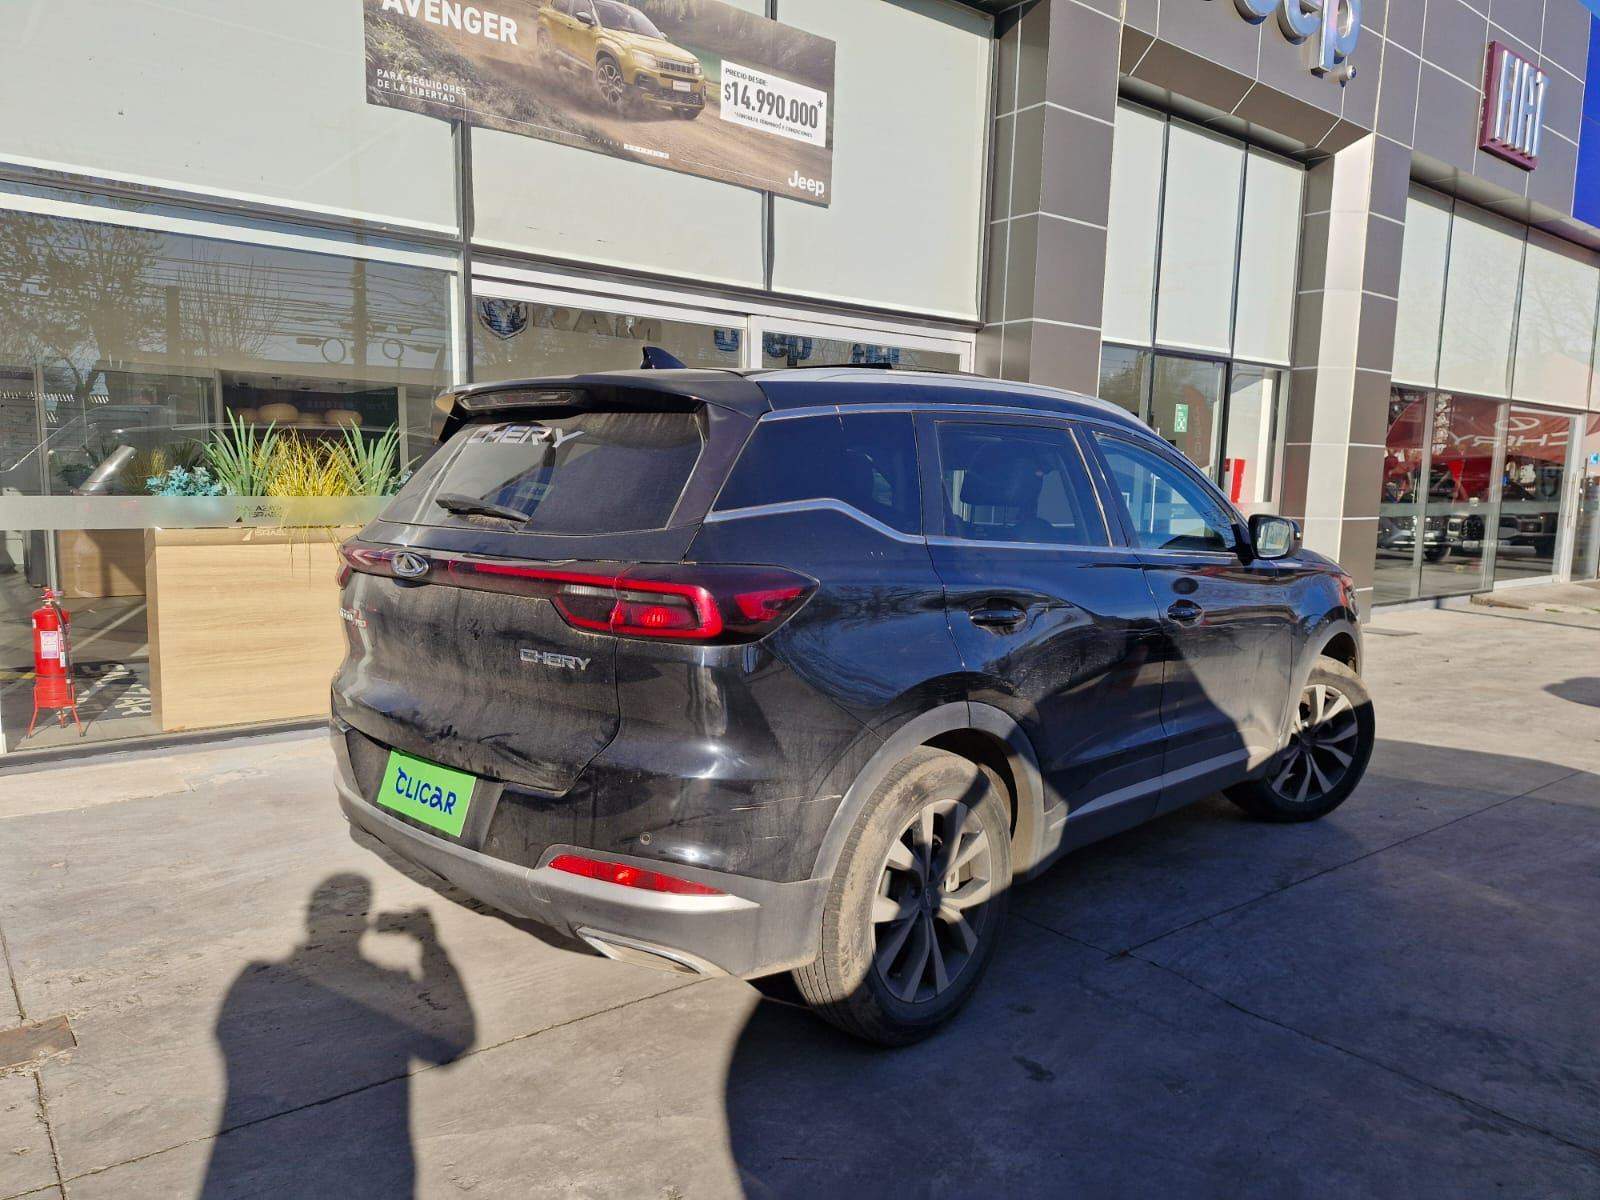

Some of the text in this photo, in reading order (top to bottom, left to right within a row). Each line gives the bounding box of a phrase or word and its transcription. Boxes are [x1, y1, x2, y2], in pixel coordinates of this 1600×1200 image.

[376, 68, 467, 97] PARA SEGUIDORES
[725, 67, 747, 80] PRECIO
[377, 79, 456, 104] DE LA LIBERTAD
[788, 170, 825, 197] Jeep
[519, 648, 592, 671] CHERY
